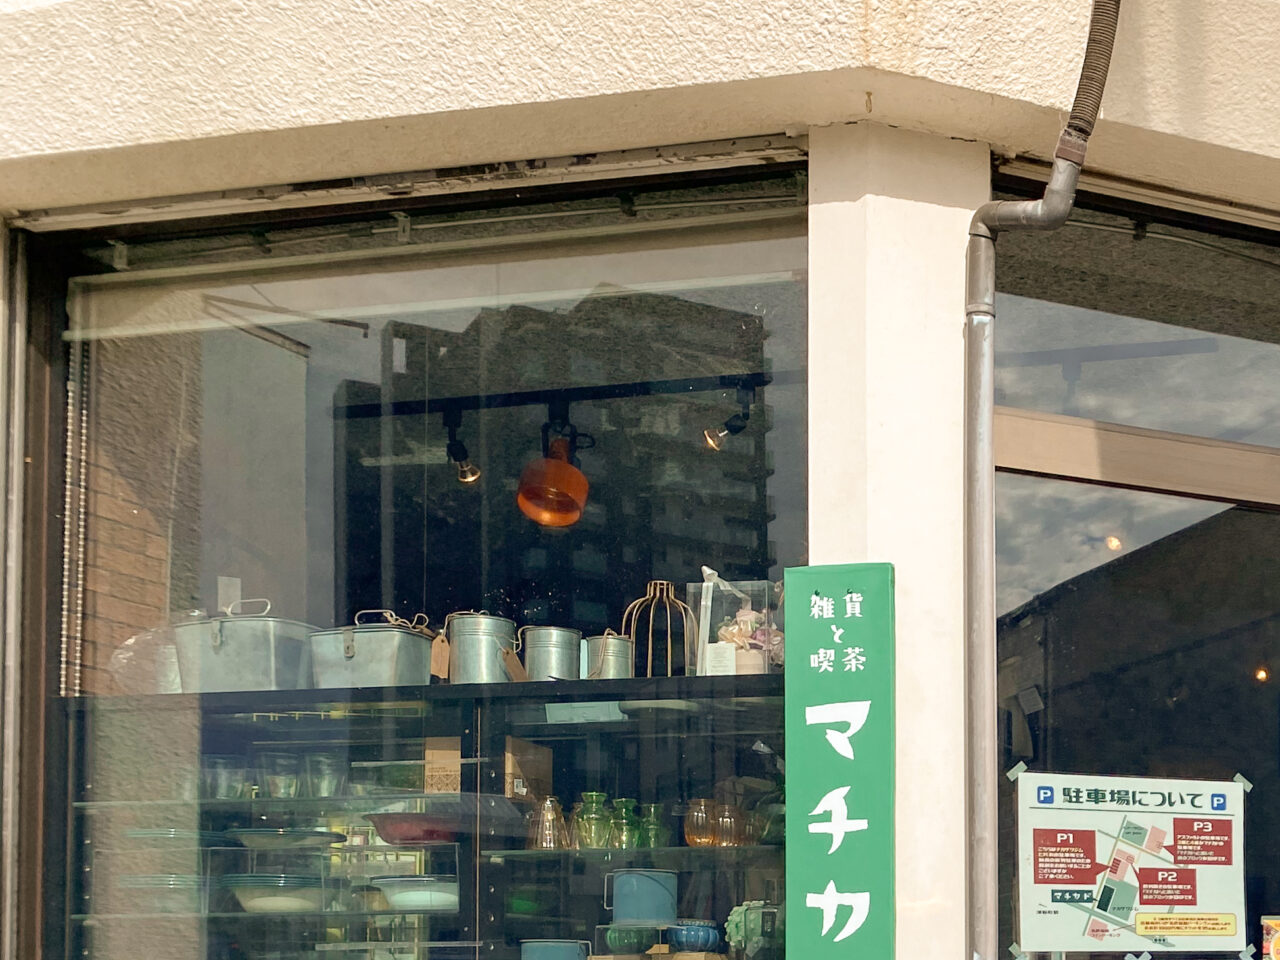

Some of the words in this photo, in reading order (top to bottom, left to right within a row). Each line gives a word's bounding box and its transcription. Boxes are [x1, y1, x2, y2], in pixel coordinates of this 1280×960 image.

[810, 592, 864, 619] 雑貨
[830, 625, 845, 643] と
[810, 647, 867, 673] 喫茶
[1062, 787, 1203, 809] 駐車場について
[1193, 821, 1213, 832] P3
[1056, 833, 1073, 844] P1
[1158, 871, 1178, 882] P2
